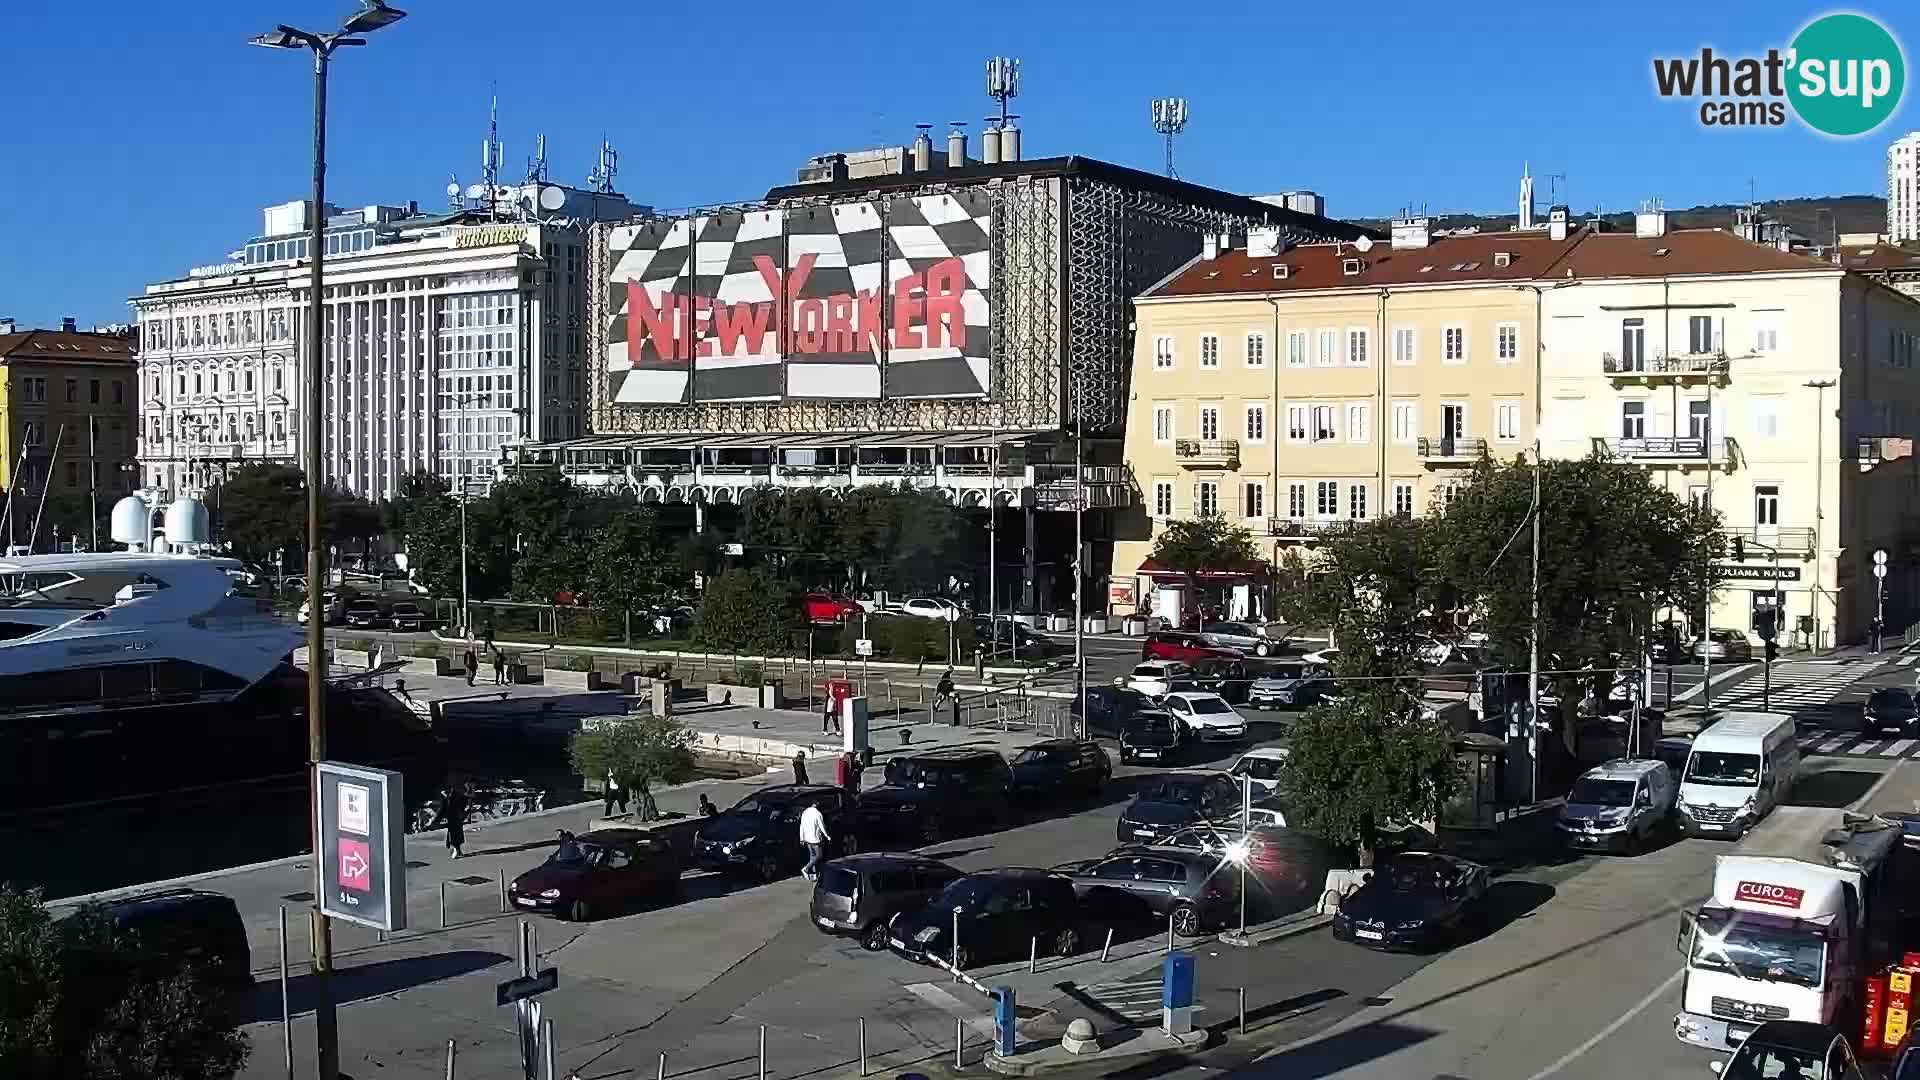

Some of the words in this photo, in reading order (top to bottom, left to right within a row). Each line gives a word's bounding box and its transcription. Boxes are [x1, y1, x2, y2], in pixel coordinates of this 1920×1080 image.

[1763, 570, 1796, 578] NAILS
[1740, 883, 1785, 898] CURO
[1733, 1002, 1766, 1014] MAN
